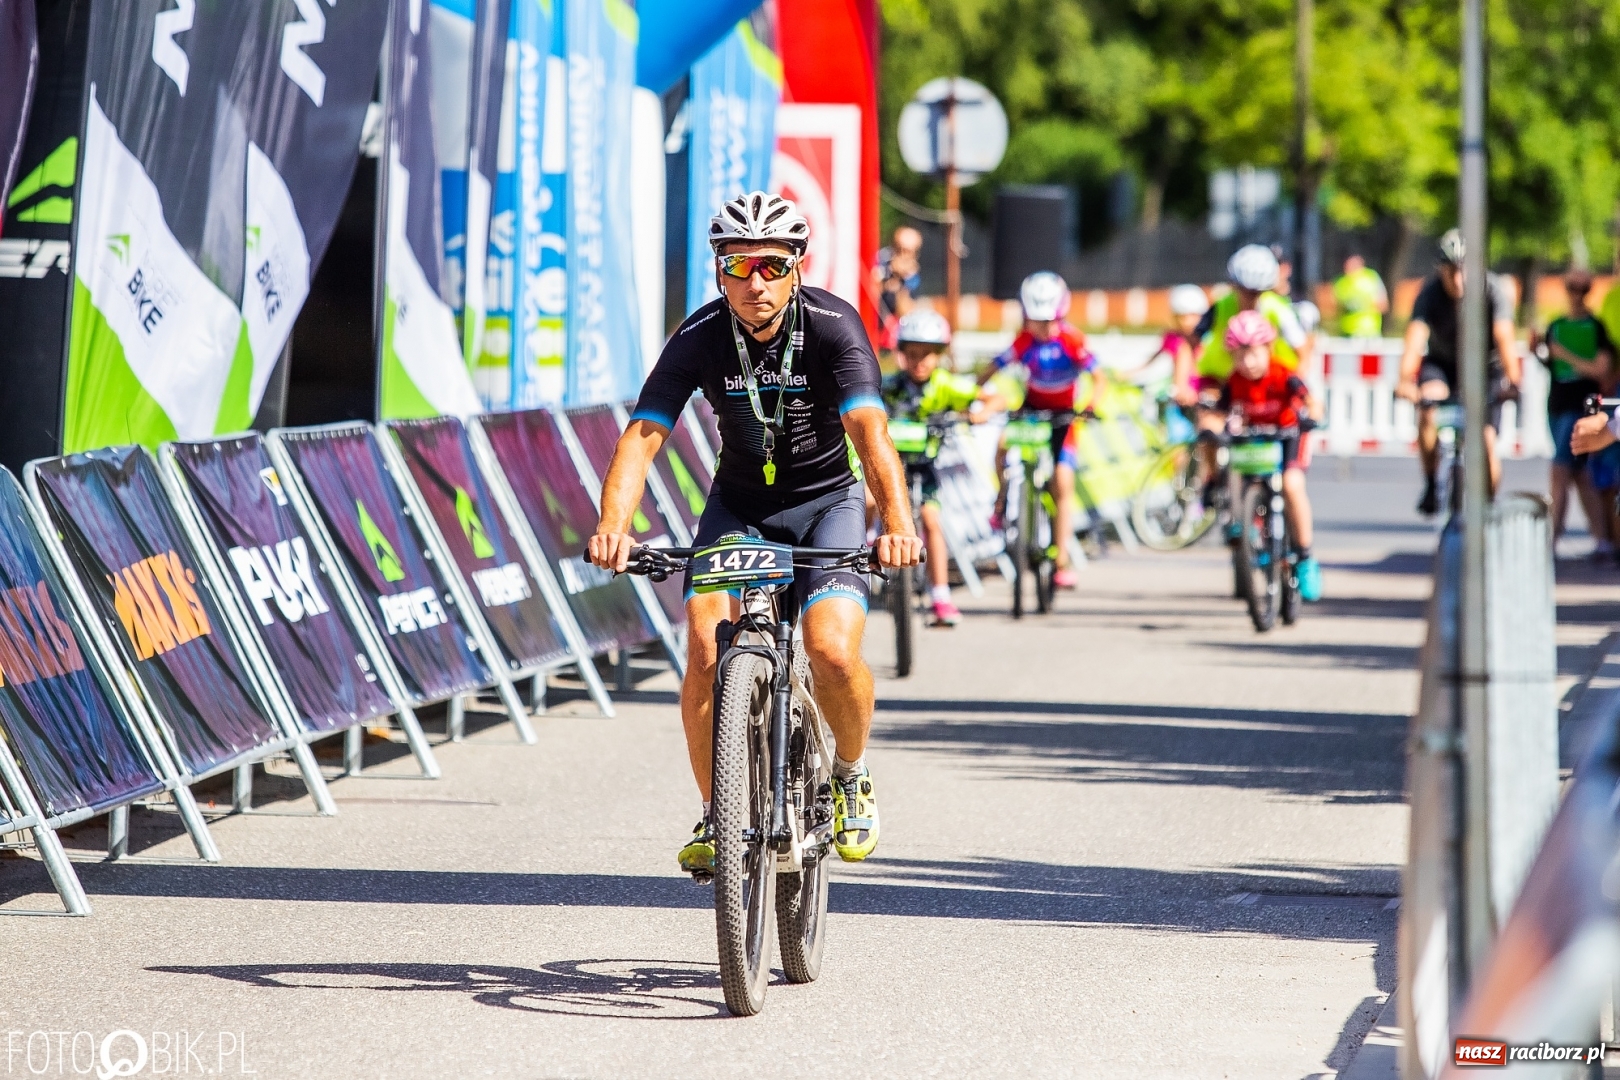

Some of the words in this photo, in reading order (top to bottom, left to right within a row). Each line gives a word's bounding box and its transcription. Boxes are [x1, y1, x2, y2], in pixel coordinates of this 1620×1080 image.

[127, 267, 164, 335] BIKE
[256, 259, 282, 324] BIKE
[724, 374, 757, 390] bik
[761, 371, 807, 387] ateier
[708, 550, 777, 573] 1472
[807, 586, 830, 601] bike
[832, 583, 865, 599] atelier
